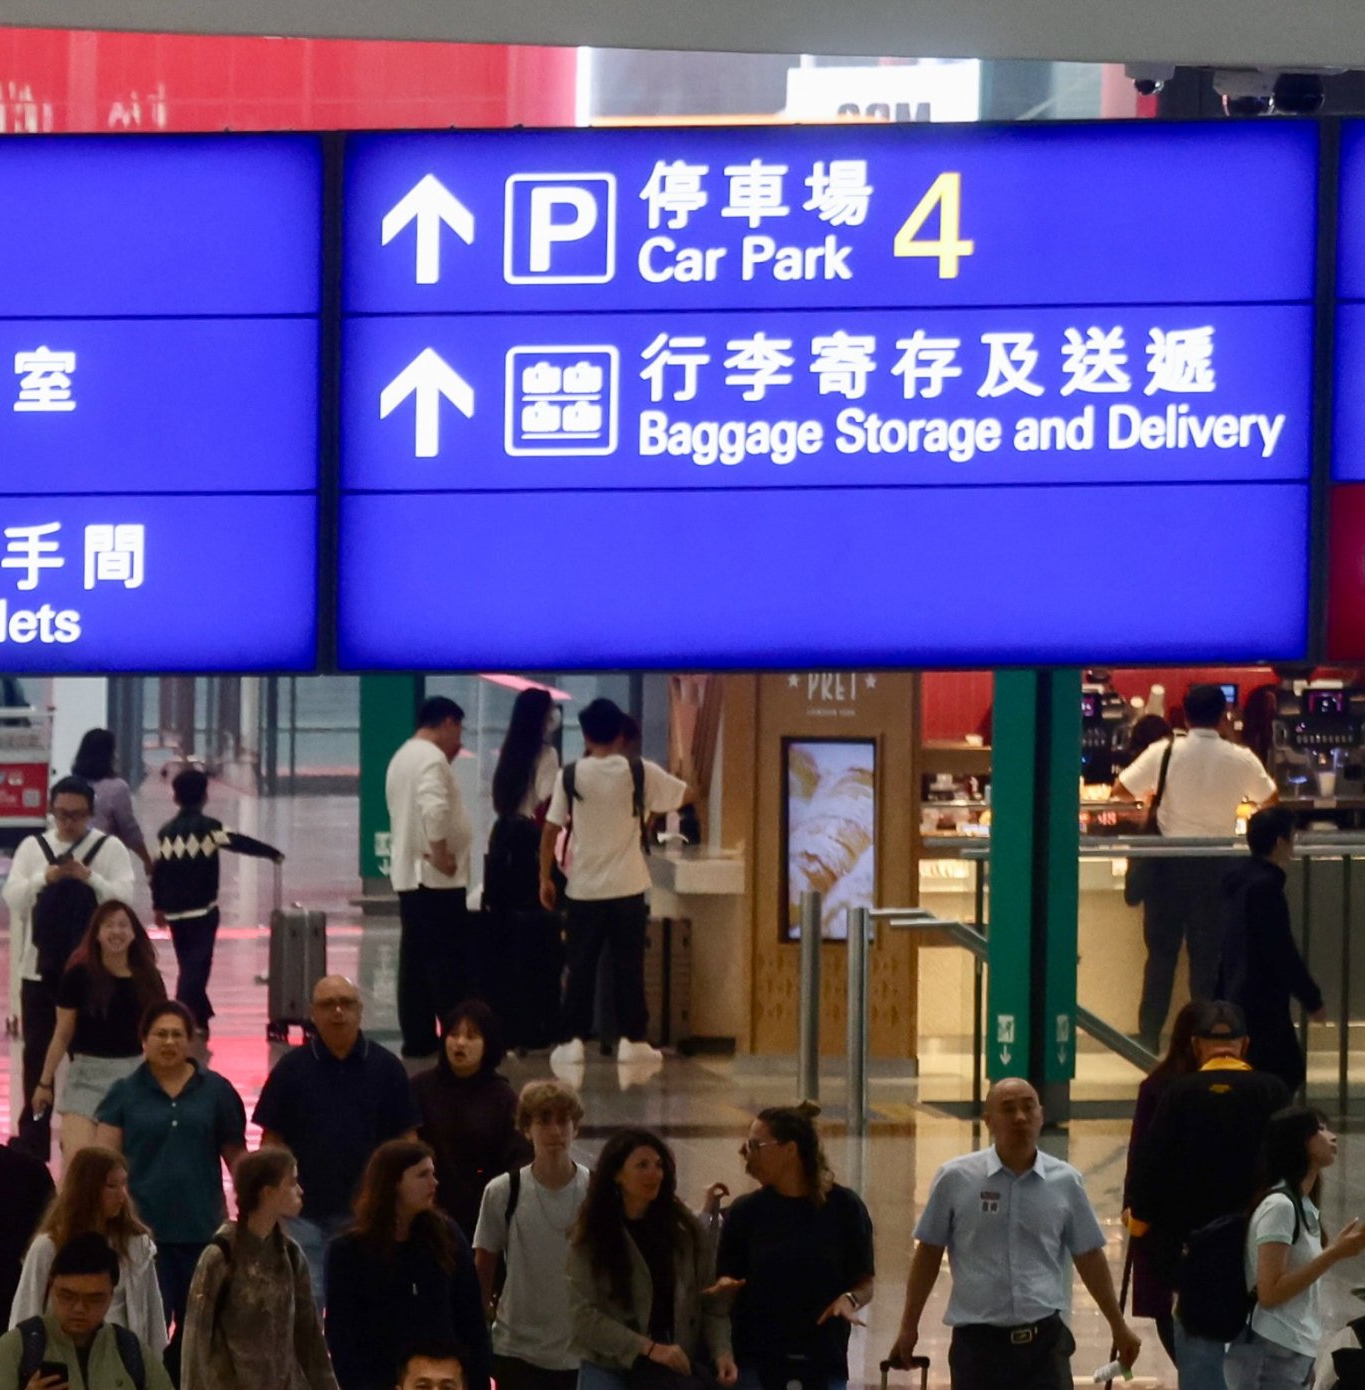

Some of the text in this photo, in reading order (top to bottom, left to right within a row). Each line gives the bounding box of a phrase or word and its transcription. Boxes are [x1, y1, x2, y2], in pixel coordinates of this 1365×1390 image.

[639, 158, 875, 230] 停車場
[893, 171, 975, 280] 4
[638, 234, 854, 283] Car Park
[639, 325, 1217, 402] 行李寄存及送遞
[639, 394, 1286, 466] Baggage Storage and Delivery
